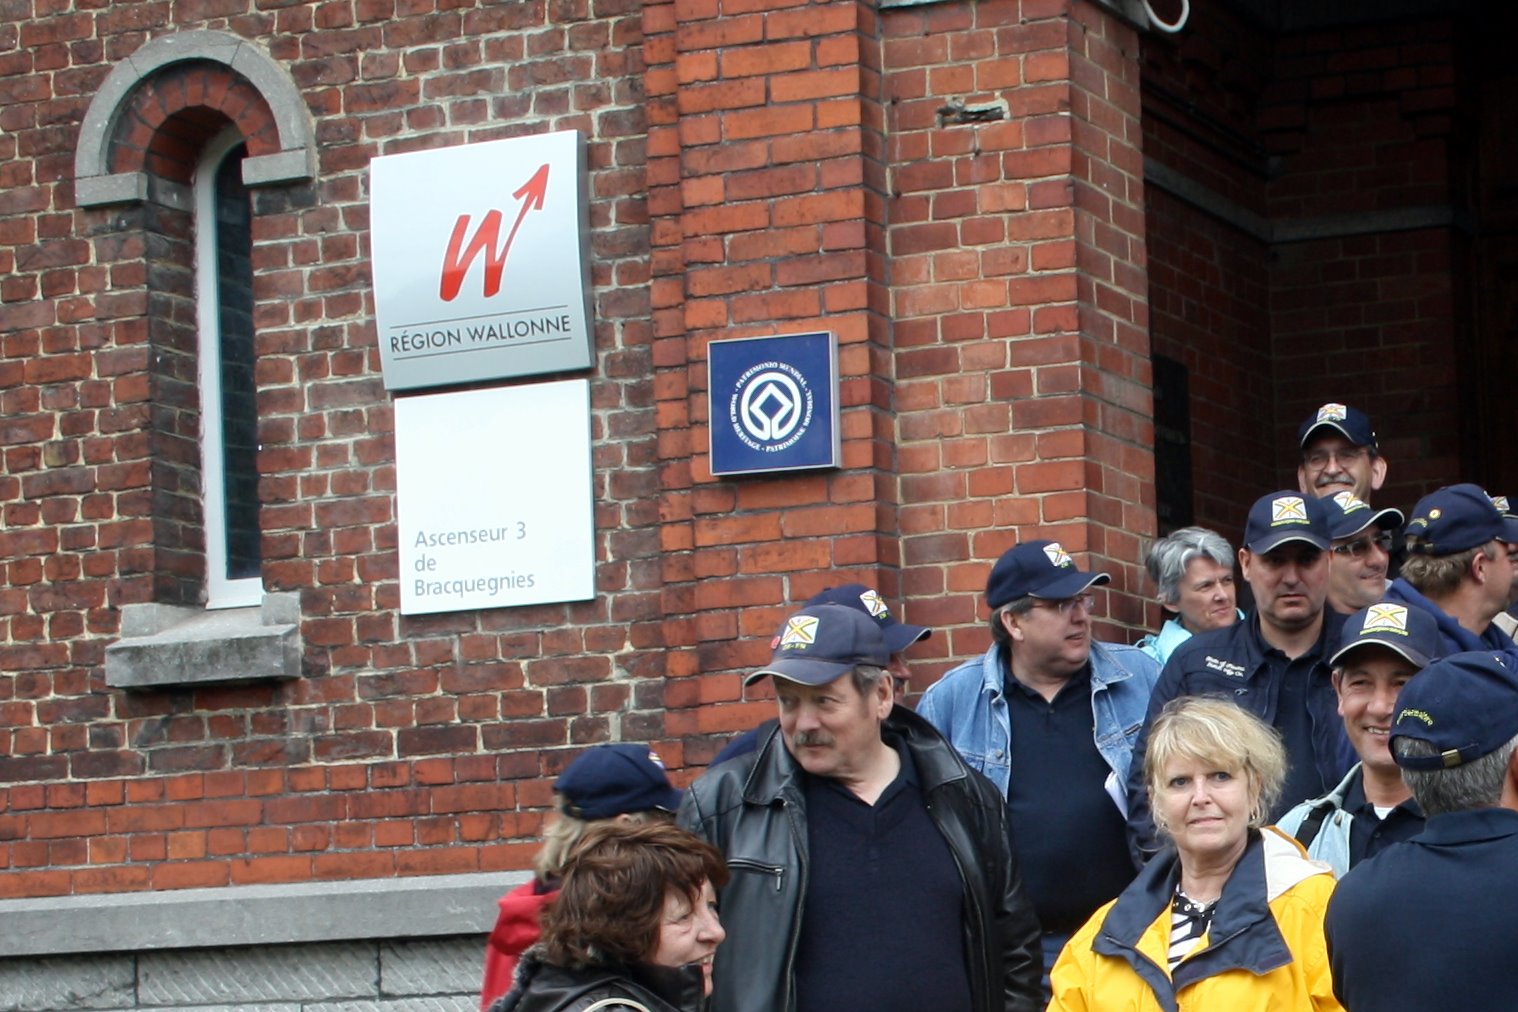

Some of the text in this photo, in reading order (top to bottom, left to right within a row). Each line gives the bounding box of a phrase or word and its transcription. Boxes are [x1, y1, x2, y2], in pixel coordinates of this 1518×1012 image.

[390, 314, 571, 353] RÉGION WALLONNE
[414, 520, 527, 548] Ascenseur 3
[414, 553, 437, 572] de
[414, 570, 535, 598] Bracquegnies
